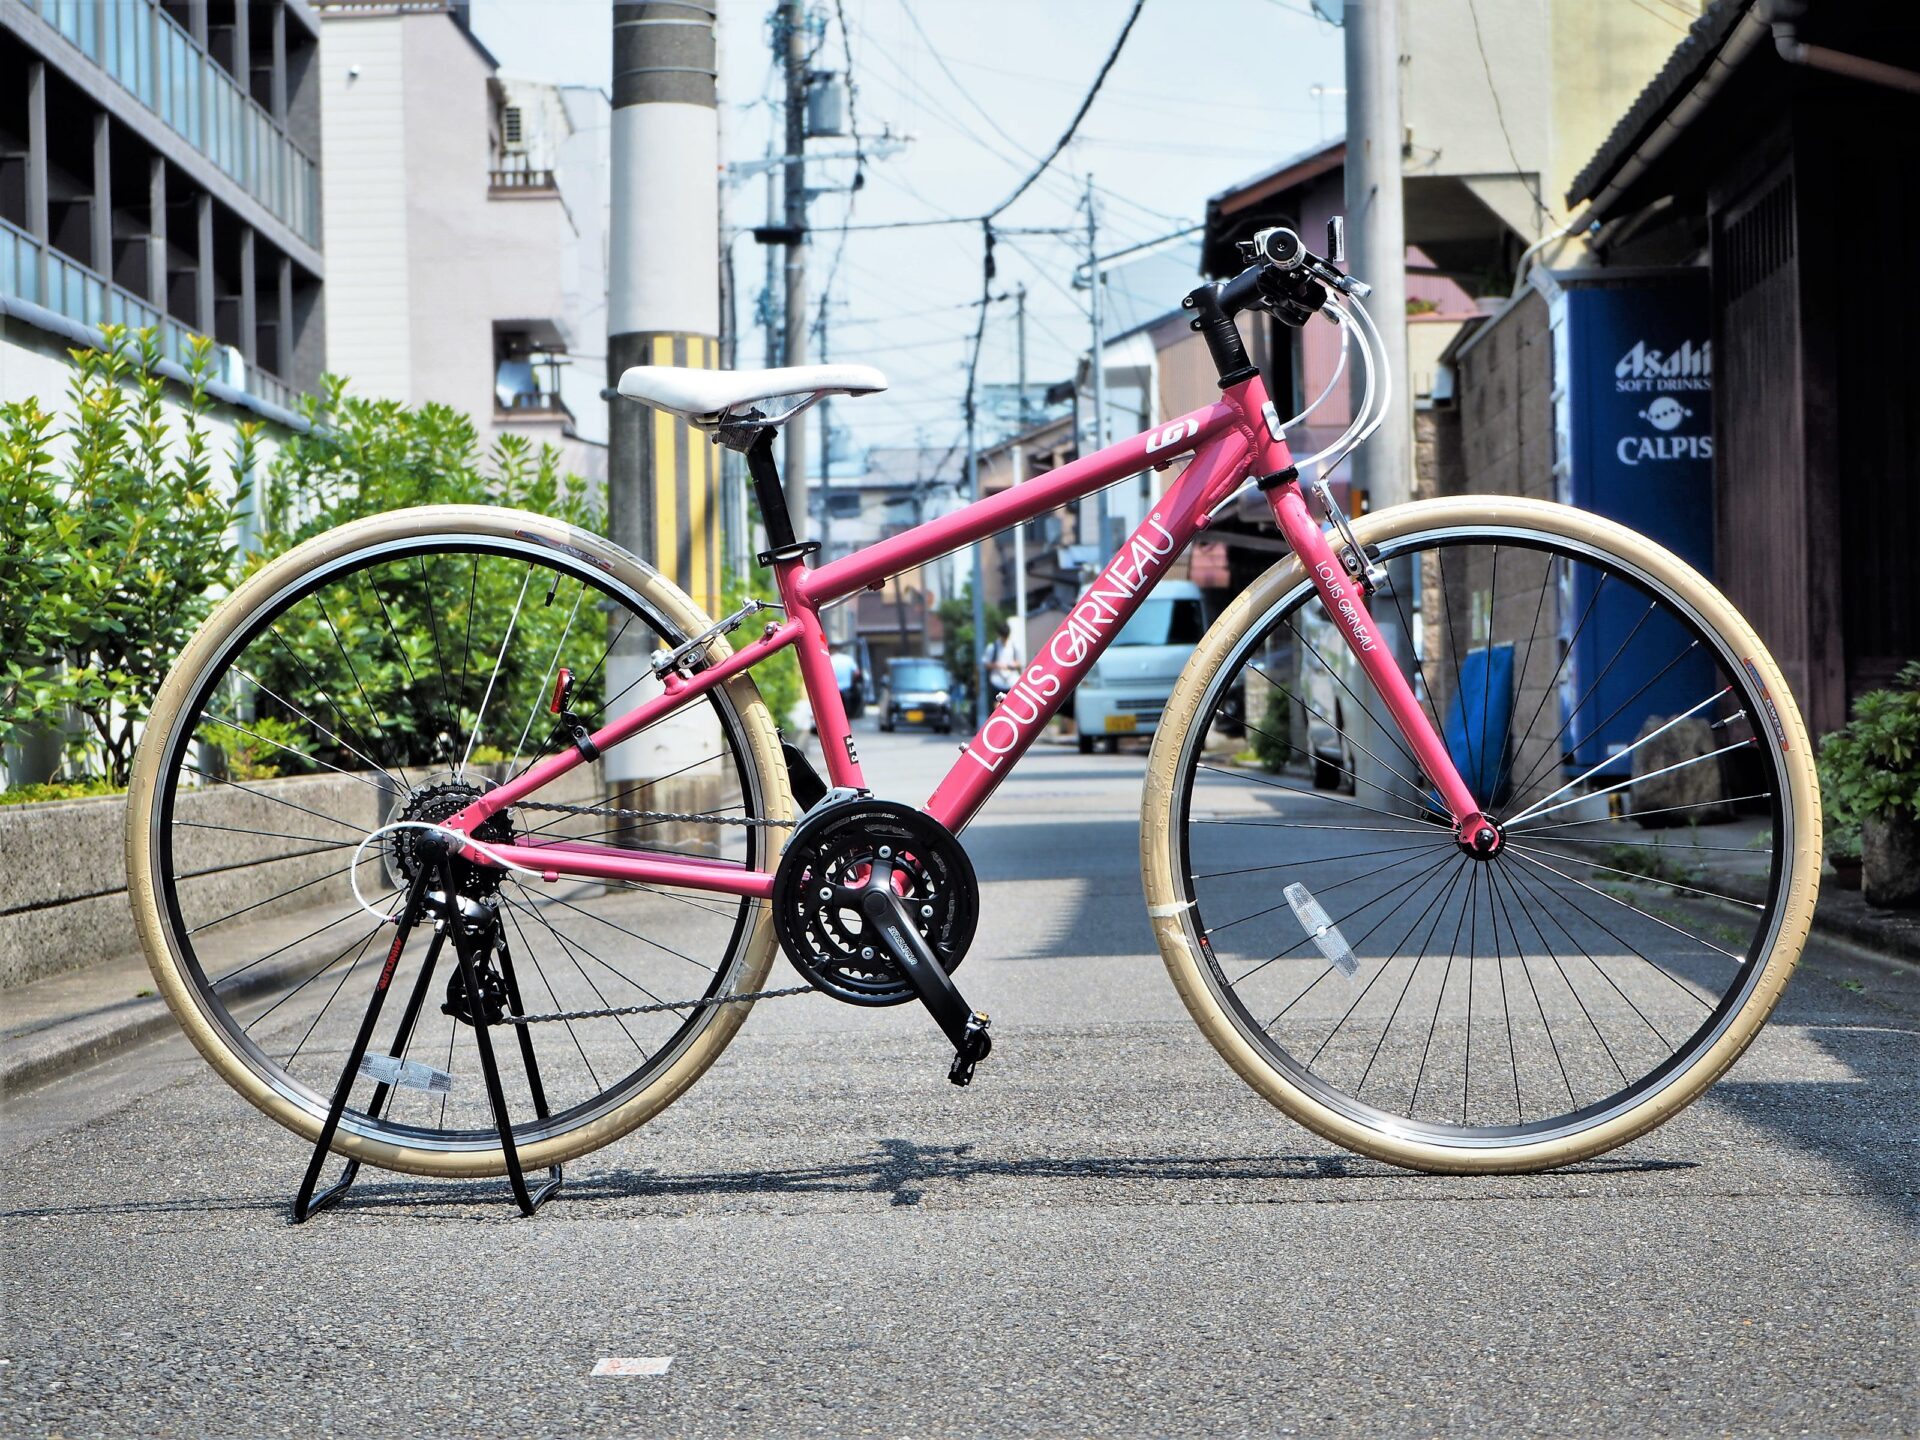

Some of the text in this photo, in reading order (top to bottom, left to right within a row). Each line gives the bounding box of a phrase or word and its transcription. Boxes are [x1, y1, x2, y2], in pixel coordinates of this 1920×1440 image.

[1615, 339, 1712, 379] Asahi
[1615, 378, 1712, 392] SOFT DRINKS
[1616, 436, 1712, 466] CALPIS
[1315, 560, 1377, 651] LOUIS GARNEAU
[968, 665, 1060, 772] LOUIS
